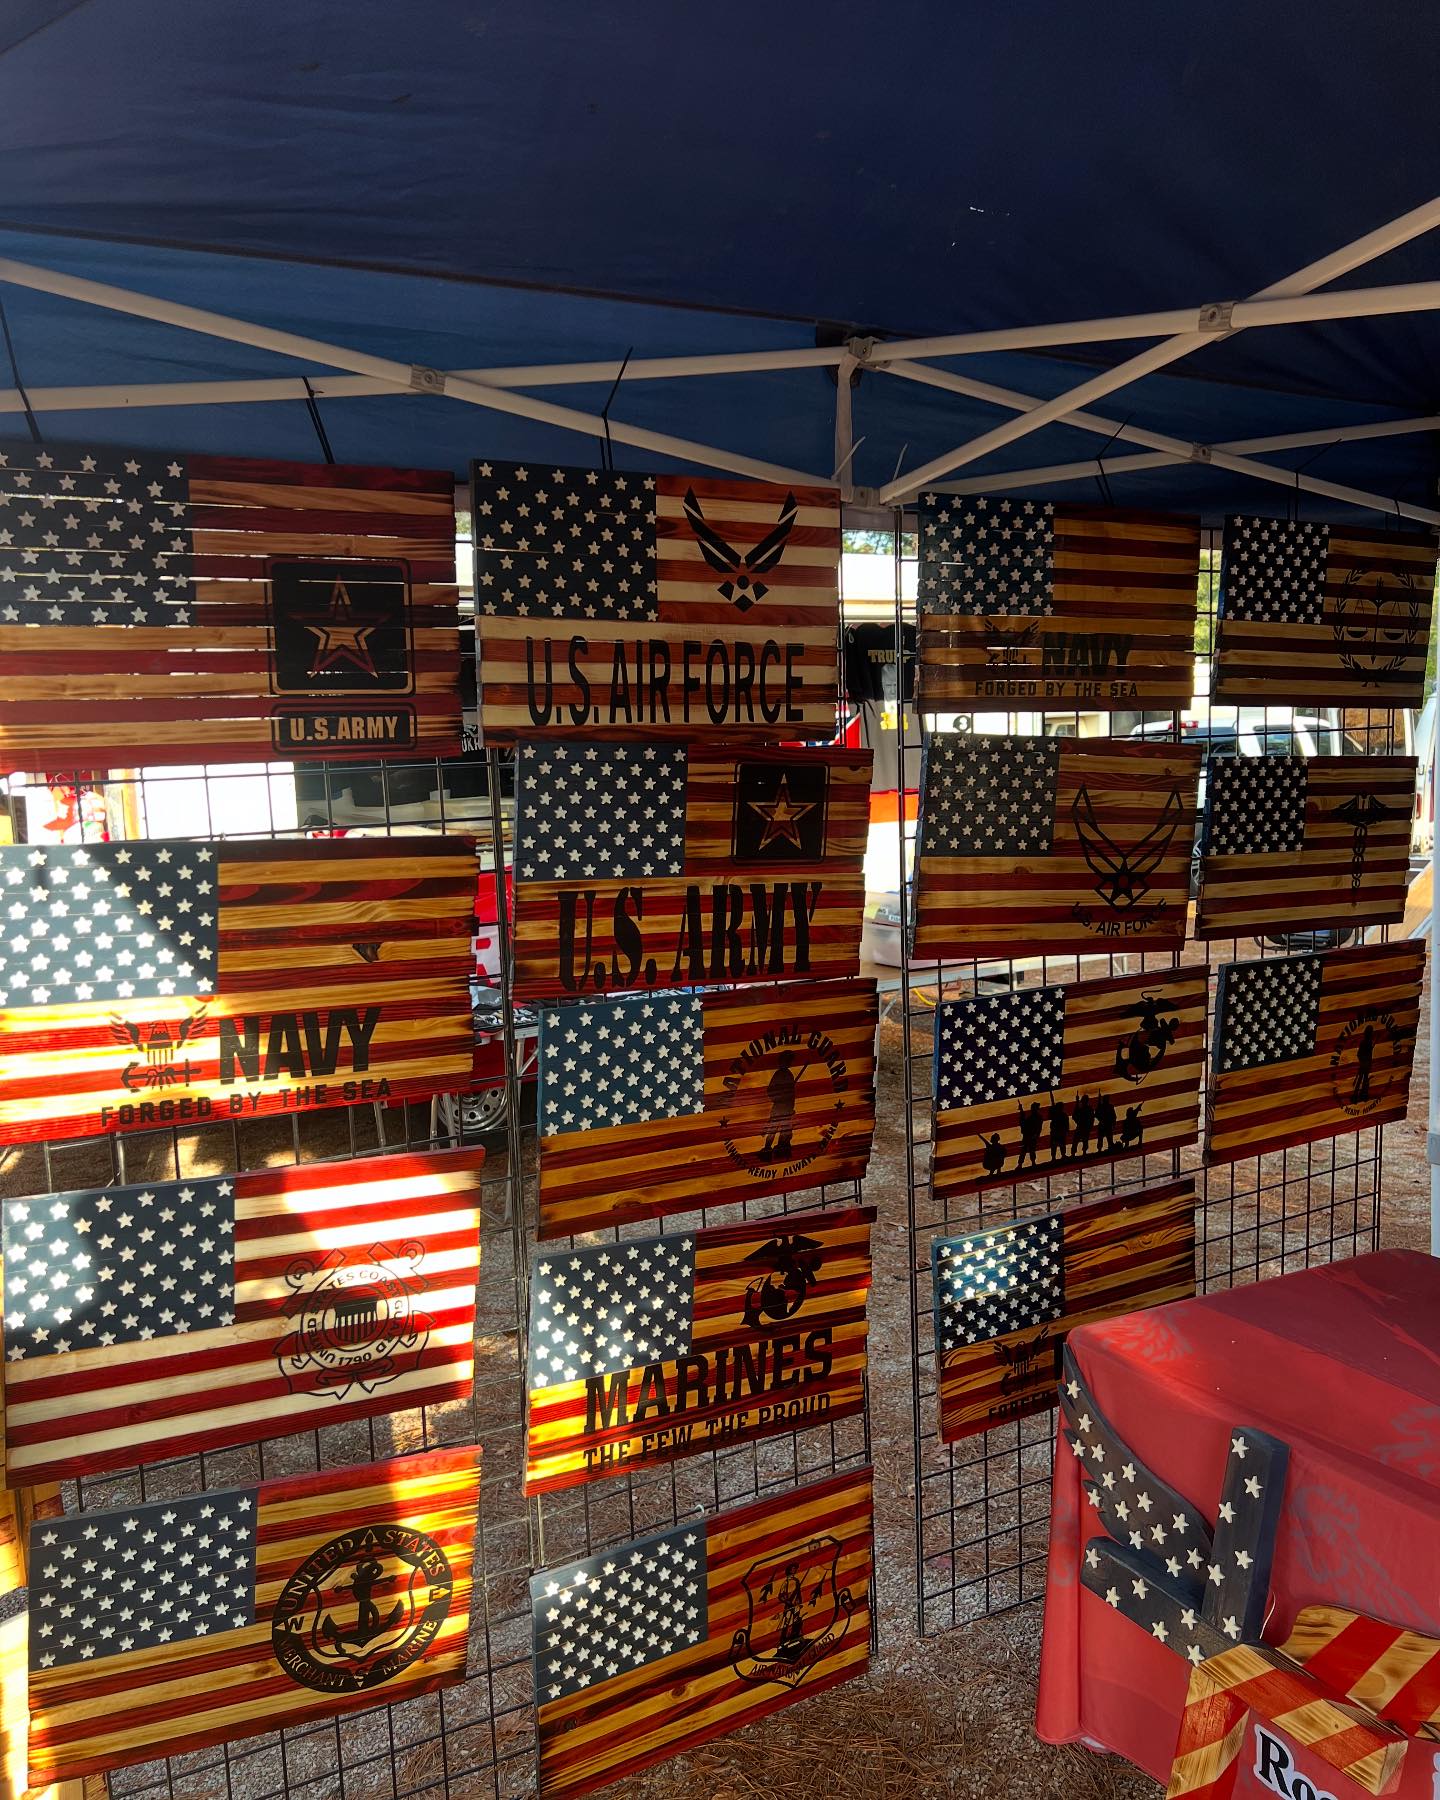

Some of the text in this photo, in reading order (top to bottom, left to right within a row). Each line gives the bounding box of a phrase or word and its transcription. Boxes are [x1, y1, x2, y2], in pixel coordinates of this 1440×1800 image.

[608, 638, 671, 724] AIR
[683, 638, 805, 725] FORCE
[1042, 631, 1133, 676] NAVY
[975, 680, 1139, 697] FORGED BY THE SEA
[557, 881, 823, 992] U.S. ARMY
[1095, 920, 1121, 937] AIR
[219, 1006, 382, 1086] NAVY
[806, 1030, 849, 1093] GUARD
[101, 1077, 393, 1128] FORGED BY THE SEA
[748, 1166, 778, 1179] READY
[782, 1153, 818, 1177] ALWAYS
[359, 1269, 402, 1299] COAST
[338, 1351, 372, 1366] 1790
[583, 1327, 833, 1436] MARINES
[583, 1440, 632, 1474] THE
[705, 1411, 749, 1440] THE
[758, 1393, 831, 1425] PROUD
[281, 1529, 446, 1612] UNITED STATES
[277, 1619, 438, 1688] MERCHANT MARINE
